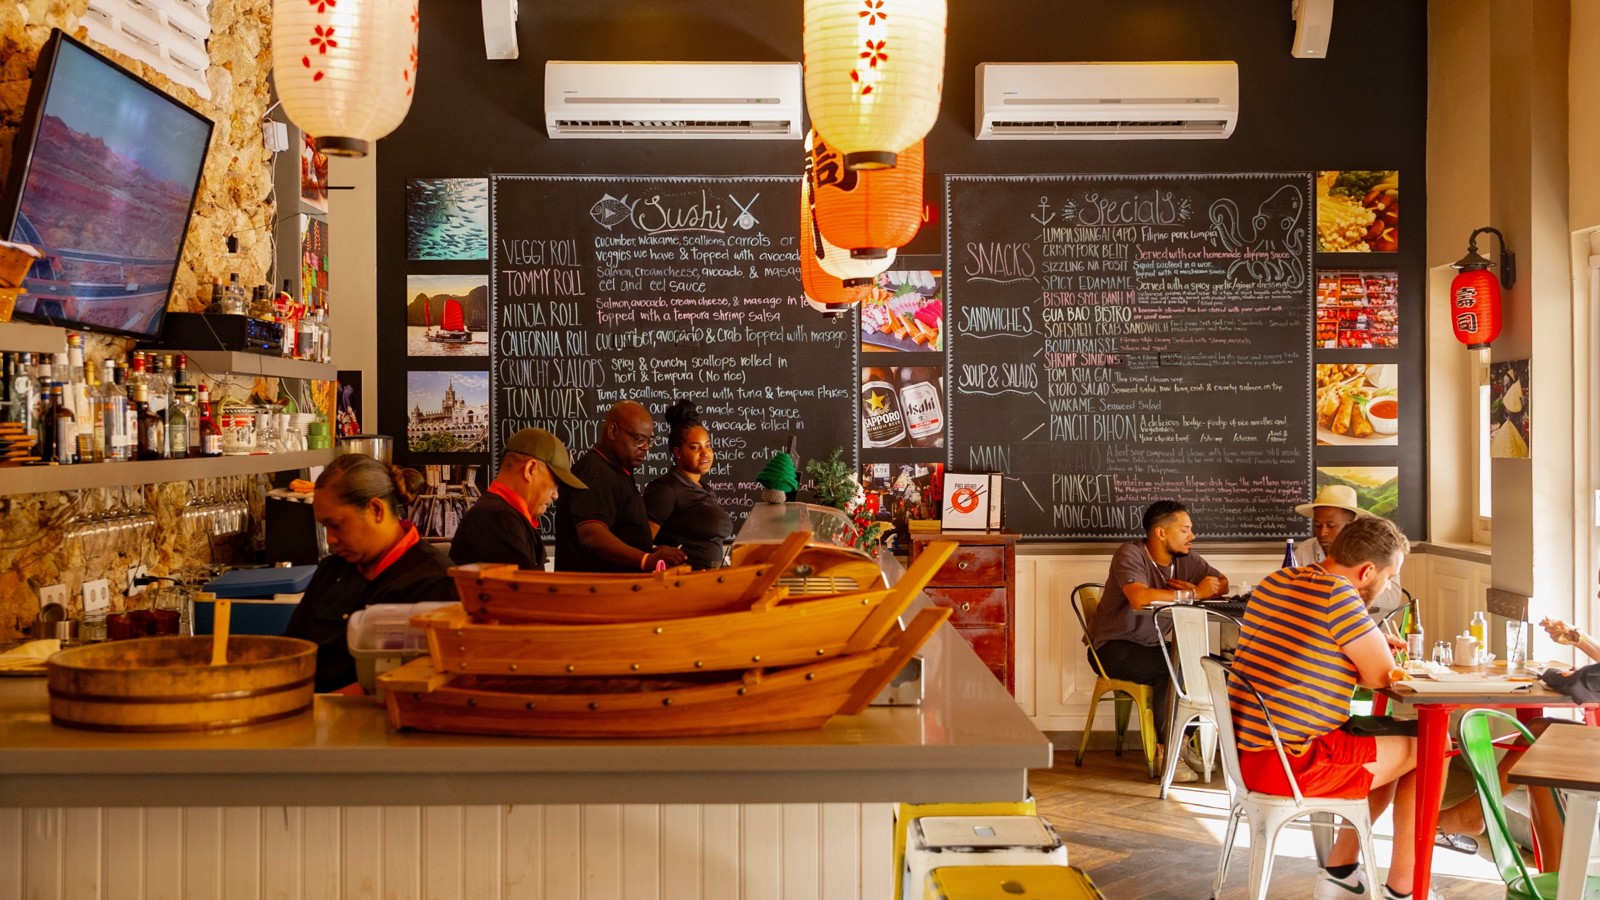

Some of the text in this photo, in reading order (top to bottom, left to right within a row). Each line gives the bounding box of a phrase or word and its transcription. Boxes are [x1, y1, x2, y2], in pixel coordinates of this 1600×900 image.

[639, 190, 727, 231] Sushi
[780, 236, 795, 246] or
[1112, 226, 1137, 243] (4PC)
[1141, 226, 1169, 243] Filipino
[502, 239, 581, 266] VEGGY ROLL
[633, 250, 647, 258] we
[650, 248, 675, 260] have
[680, 246, 689, 260] &
[693, 248, 729, 265] topped
[734, 249, 755, 261] with
[965, 242, 1035, 277] SNACKS
[1043, 244, 1128, 260] CRISPY PORK BELLY
[1135, 244, 1269, 261] Served with our homemade dipping
[597, 266, 801, 282] Salmon, & masag
[1042, 261, 1100, 273] SIZZLING NA
[502, 268, 585, 296] TOMMY ROLL
[599, 278, 706, 292] eel and eel sauce
[1042, 276, 1134, 290] SPICY EDAMAME
[1136, 277, 1166, 290] Served
[1167, 277, 1183, 290] with
[1191, 282, 1210, 293] spicy
[733, 296, 740, 306] &
[744, 298, 782, 309] masago
[787, 296, 797, 305] in
[1043, 291, 1098, 307] BISTRO STYLE
[503, 301, 582, 327] NINJA ROLL
[596, 308, 745, 328] topped with a tempura shrimp
[958, 306, 1033, 333] SANDWICHES
[1042, 306, 1132, 322] GUA BAO BISTRO
[705, 327, 716, 344] &
[746, 326, 784, 347] topped
[787, 325, 808, 342] with
[810, 331, 847, 348] masago
[1096, 322, 1121, 335] CRAB
[1123, 322, 1169, 335] SANDWICH
[501, 330, 591, 357] CALIFORNIA ROLL
[1045, 338, 1118, 353] BOUILLABAISSE
[639, 353, 787, 371] & scallops rolled in
[1043, 352, 1077, 369] SHRIMP
[500, 358, 605, 388] CRUNCHY SCALLOPS
[614, 370, 636, 383] nori
[640, 371, 649, 383] &
[651, 369, 693, 386] tempura
[724, 370, 746, 384] rice)
[958, 362, 1038, 389] SOUP & SALADS
[1044, 367, 1112, 383] TOM KHA GAI
[596, 386, 815, 402] Tuna & topped with tuna & tempura
[1048, 382, 1110, 397] KYOTO SALAD
[1206, 383, 1212, 391] &
[503, 387, 588, 418] TUNA LOVER
[649, 402, 669, 414] our
[906, 397, 936, 417] Asahi
[1049, 399, 1095, 412] WAKAME
[1100, 398, 1161, 412] Seaweed Salad
[706, 402, 735, 416] made
[737, 406, 765, 422] spicy
[864, 410, 900, 428] SAPPORO
[1140, 414, 1146, 427] A
[1148, 414, 1179, 427] delicious
[1274, 416, 1287, 425] and
[563, 419, 599, 448] SPICY
[761, 419, 790, 431] rolled
[796, 420, 804, 430] in
[1050, 413, 1137, 442] PANCIT BIHON
[752, 446, 769, 460] out
[969, 445, 1010, 474] MAIN
[1052, 474, 1111, 503] PINAKBET
[1053, 504, 1125, 529] MONGOLIAN
